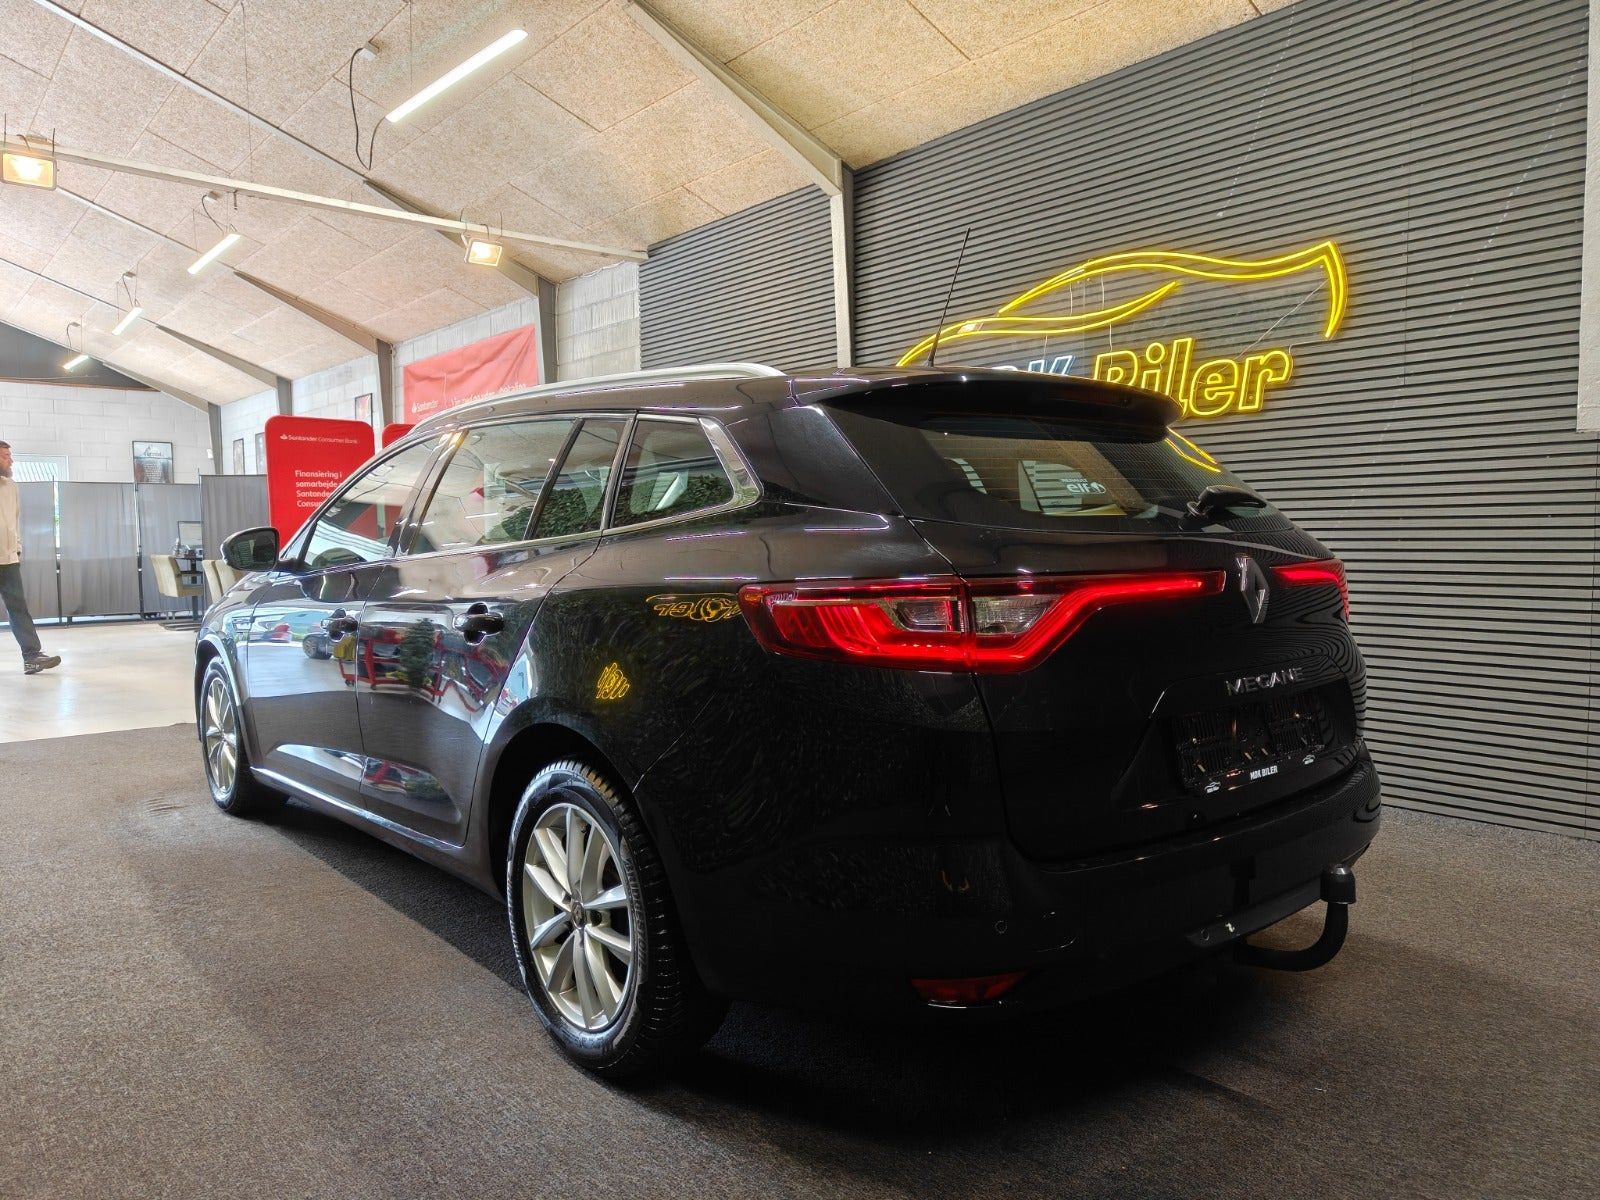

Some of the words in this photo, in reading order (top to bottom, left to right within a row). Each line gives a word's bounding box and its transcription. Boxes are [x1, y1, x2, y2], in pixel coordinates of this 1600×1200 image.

[288, 434, 317, 442] Santander
[295, 470, 338, 479] Finansiering
[295, 481, 338, 489] samarbejde
[296, 490, 331, 498] Santande
[1224, 667, 1304, 696] MEGANE
